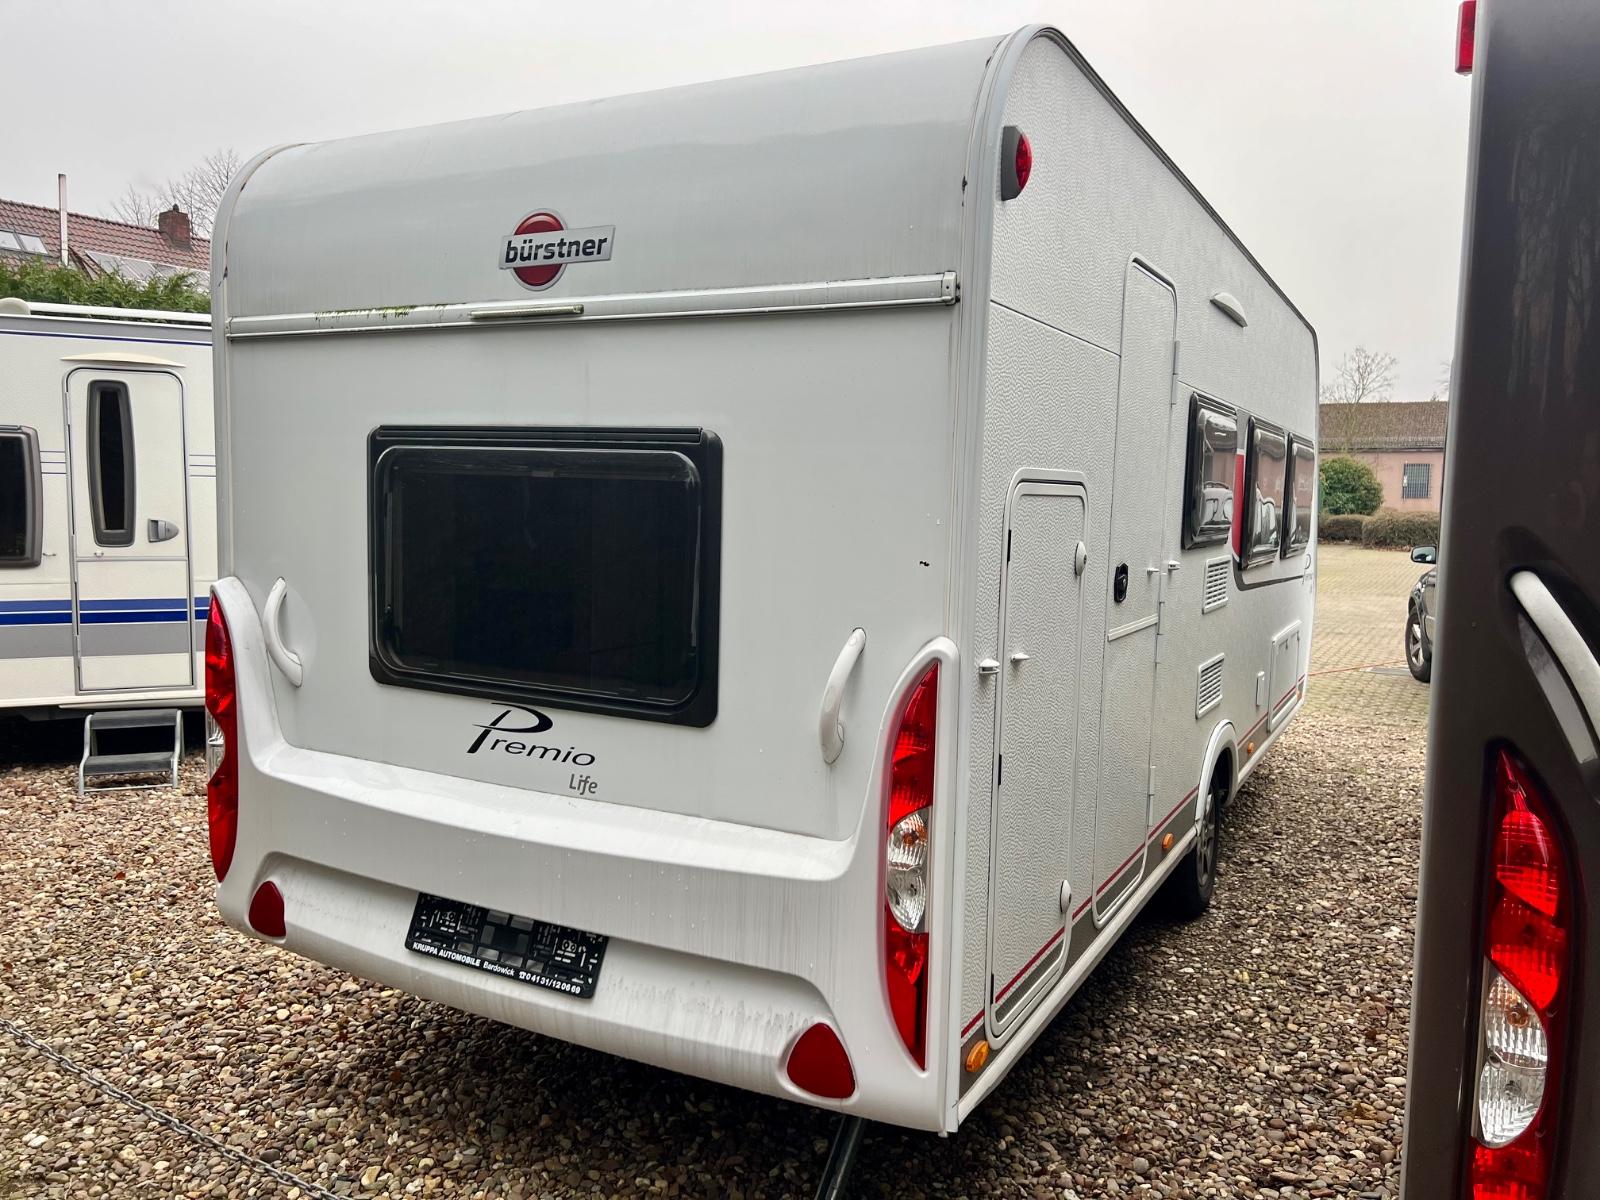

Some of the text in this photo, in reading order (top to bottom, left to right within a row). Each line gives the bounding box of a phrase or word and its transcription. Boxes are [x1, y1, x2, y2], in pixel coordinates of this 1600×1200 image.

[505, 238, 607, 263] bürstner
[467, 702, 595, 766] Premio
[569, 773, 598, 795] Life
[413, 942, 438, 956] KRUPPA
[439, 950, 481, 967] AUTOMOBILE
[483, 961, 515, 977] Bardowick
